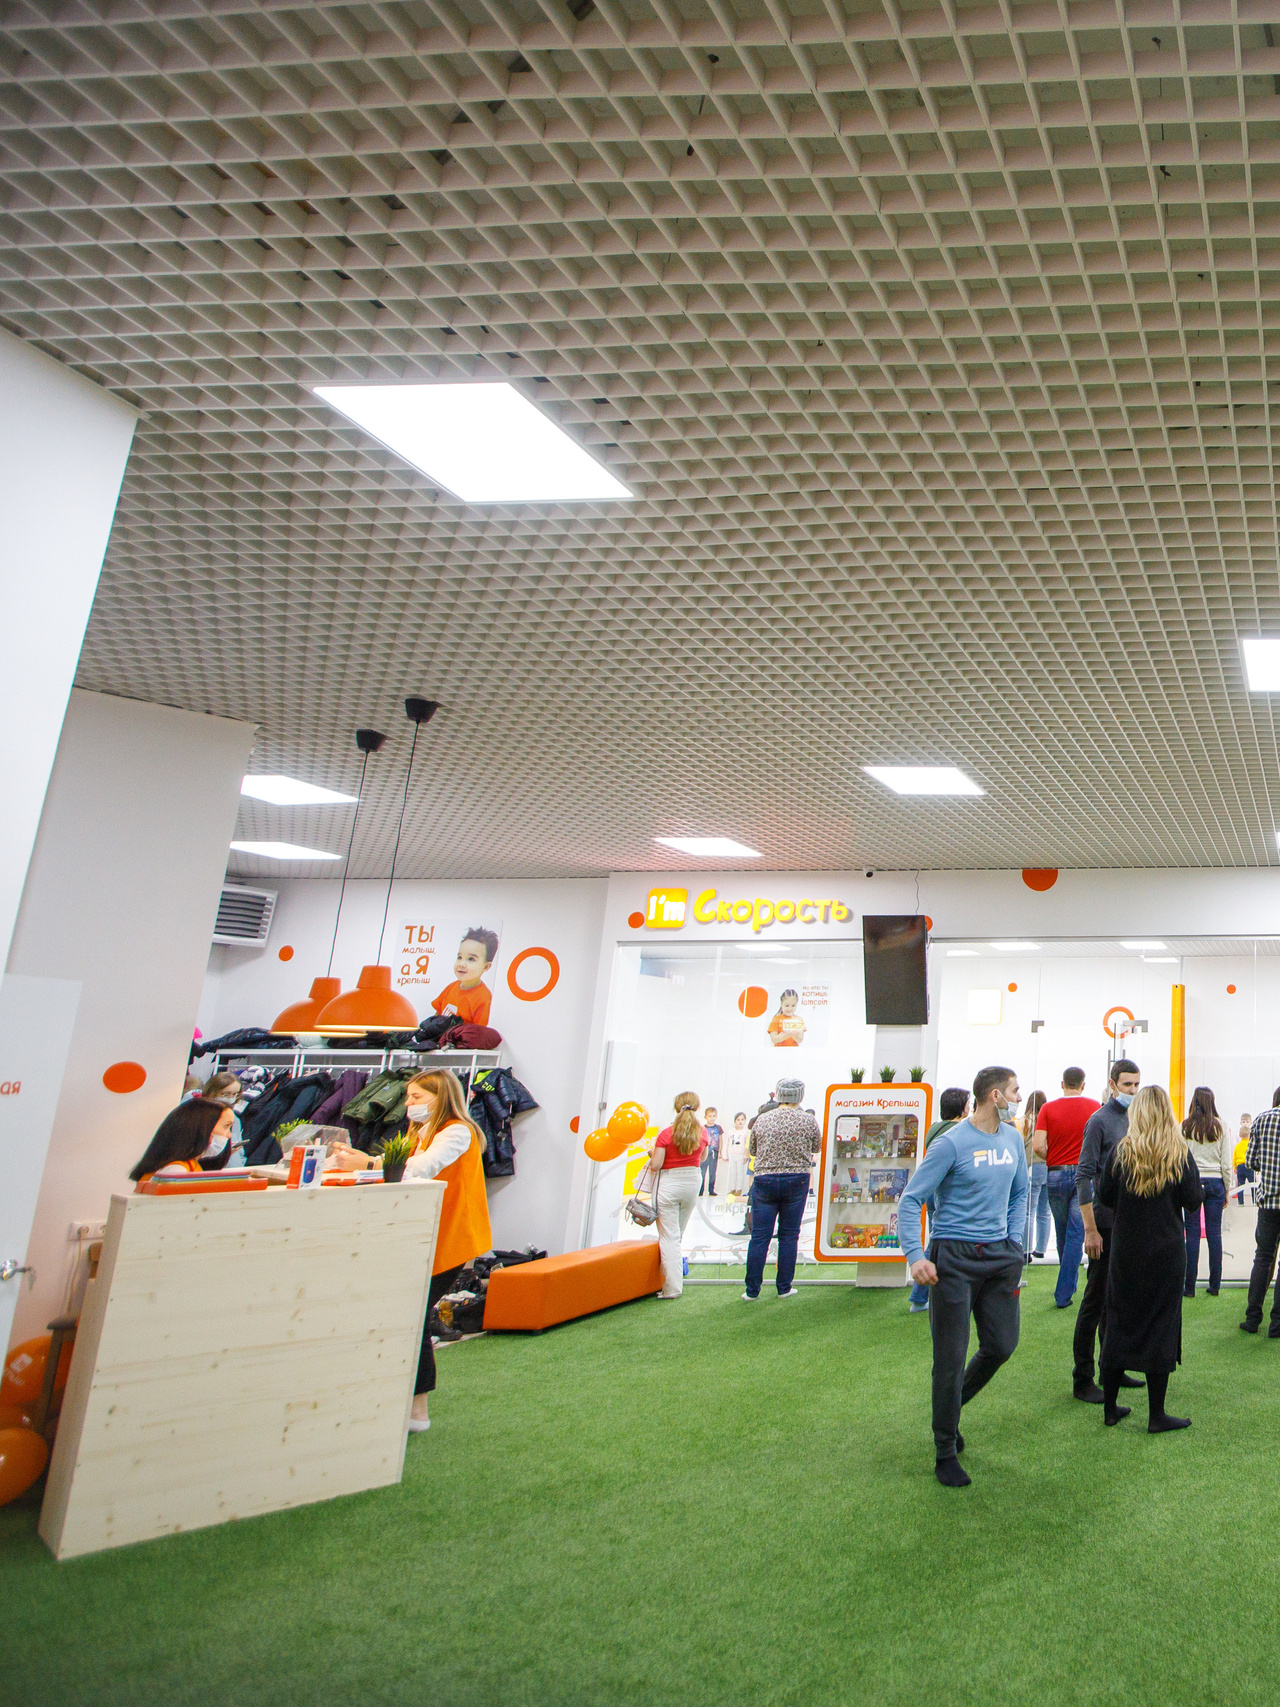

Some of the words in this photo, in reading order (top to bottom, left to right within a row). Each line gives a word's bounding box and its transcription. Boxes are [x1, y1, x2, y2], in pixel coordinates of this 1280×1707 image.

[648, 894, 686, 922] I'm
[693, 888, 849, 931] Скорость
[405, 925, 435, 944] ТЫ
[402, 946, 436, 955] малыш,
[401, 963, 411, 976] а
[416, 955, 429, 975] Я
[397, 977, 430, 986] крепыш
[0, 1081, 22, 1095] ая
[877, 1098, 920, 1110] Крепыша
[973, 1148, 1014, 1168] FILA
